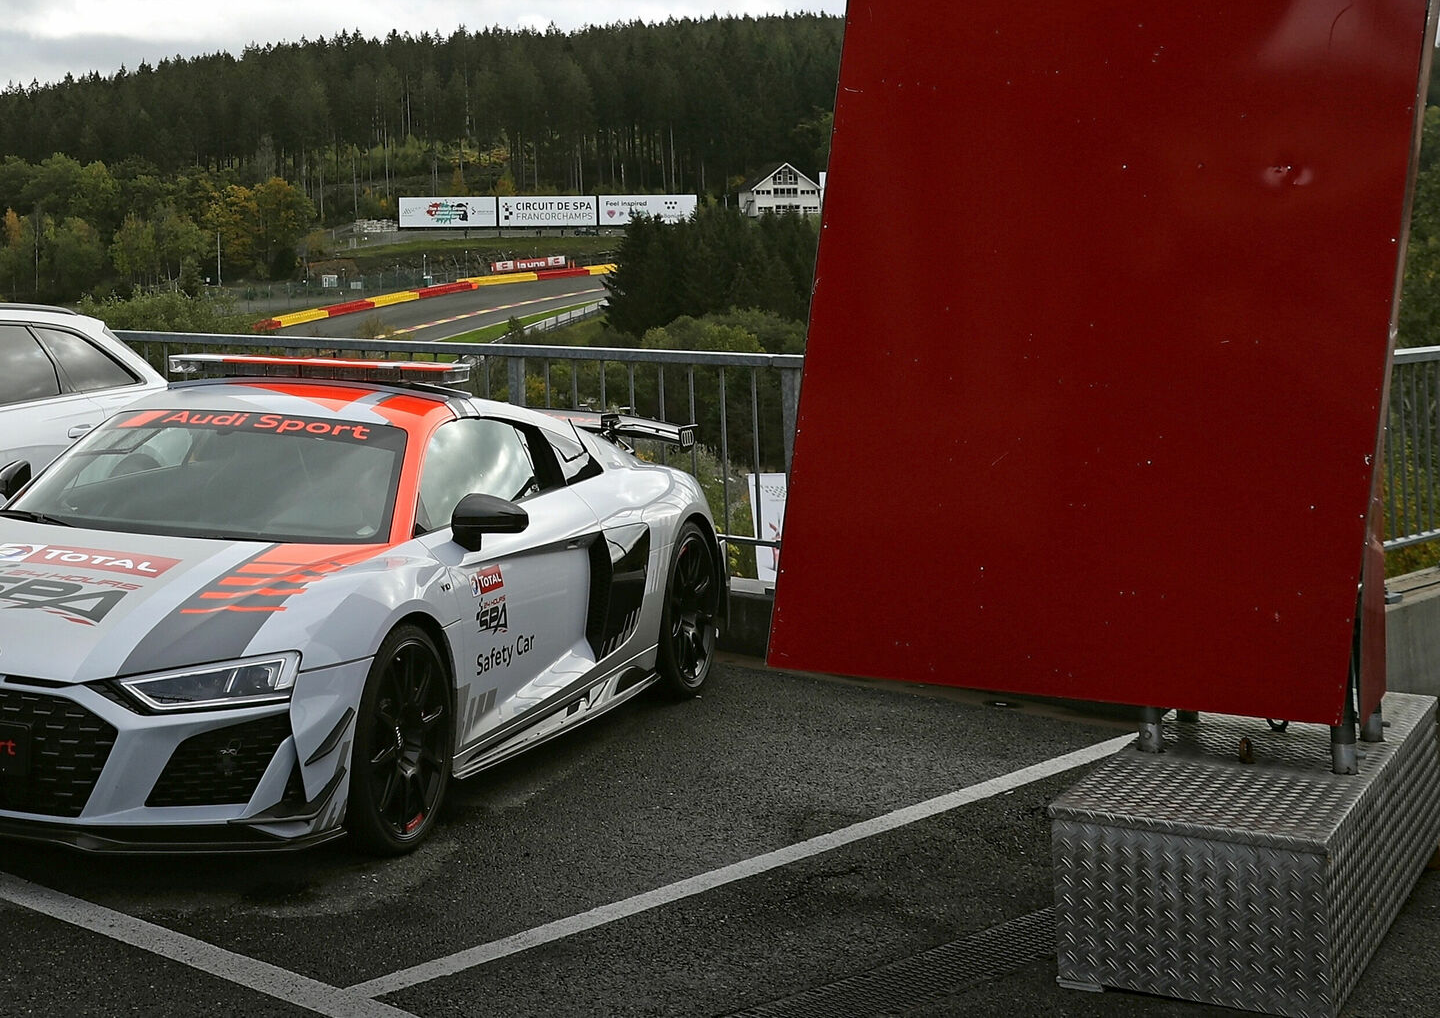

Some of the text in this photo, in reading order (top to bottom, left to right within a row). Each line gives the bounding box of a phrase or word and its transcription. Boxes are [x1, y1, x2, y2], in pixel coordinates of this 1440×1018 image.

[515, 200, 592, 211] CIRCUIT DE SPA
[516, 212, 593, 221] FRANCORCHAMPS
[162, 410, 371, 440] Audi Sport
[44, 548, 159, 573] TOTAL
[7, 568, 144, 591] 24 HOURS
[479, 573, 502, 587] TOTAL
[477, 602, 509, 634] SPA
[476, 634, 535, 677] Safety Car
